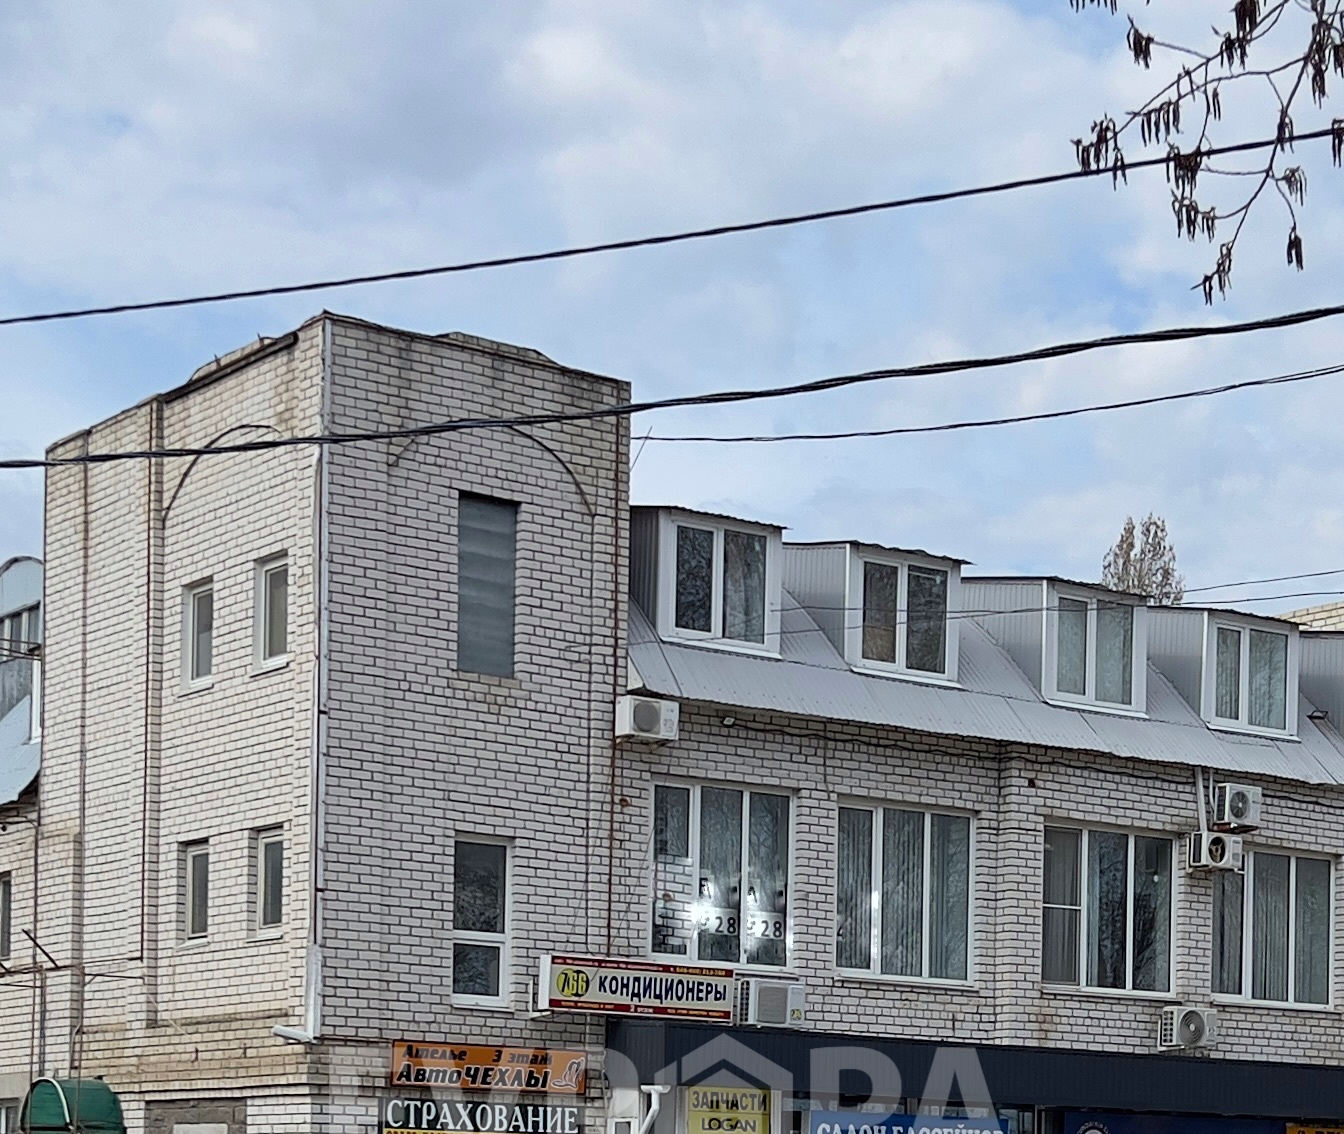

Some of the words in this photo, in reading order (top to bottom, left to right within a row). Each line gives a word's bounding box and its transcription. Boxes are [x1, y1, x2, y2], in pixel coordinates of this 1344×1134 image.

[599, 975, 727, 1004] КОНДИЦИОНЕРЫ
[402, 1044, 467, 1062] Ателье
[492, 1050, 503, 1063] 3
[507, 1052, 552, 1065] этаж
[692, 1090, 767, 1111] ЗАПЧАСТИ
[386, 1099, 578, 1133] СТРАХОВАНИЕ
[701, 1117, 757, 1132] LOGAN
